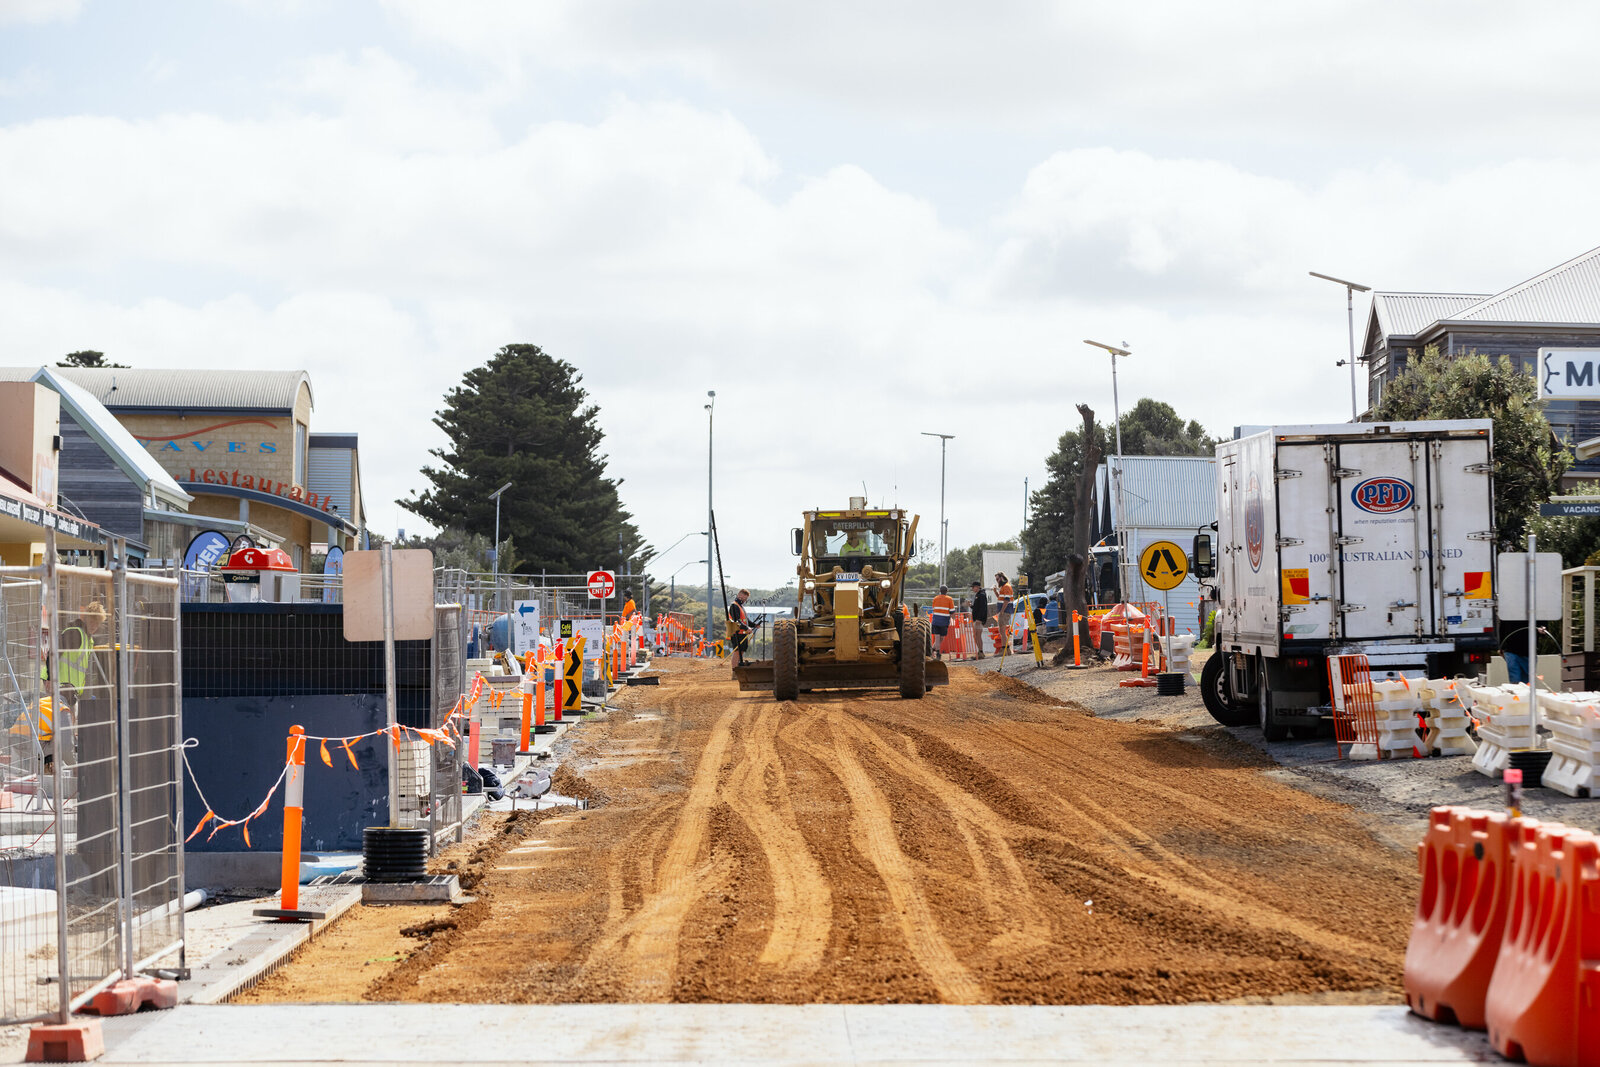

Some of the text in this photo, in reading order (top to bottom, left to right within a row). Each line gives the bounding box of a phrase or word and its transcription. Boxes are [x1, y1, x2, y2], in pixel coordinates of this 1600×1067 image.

[1566, 361, 1600, 386] M
[1362, 482, 1408, 505] PFD
[832, 521, 875, 530] CATERPILLAR
[1275, 708, 1309, 717] ISUZ
